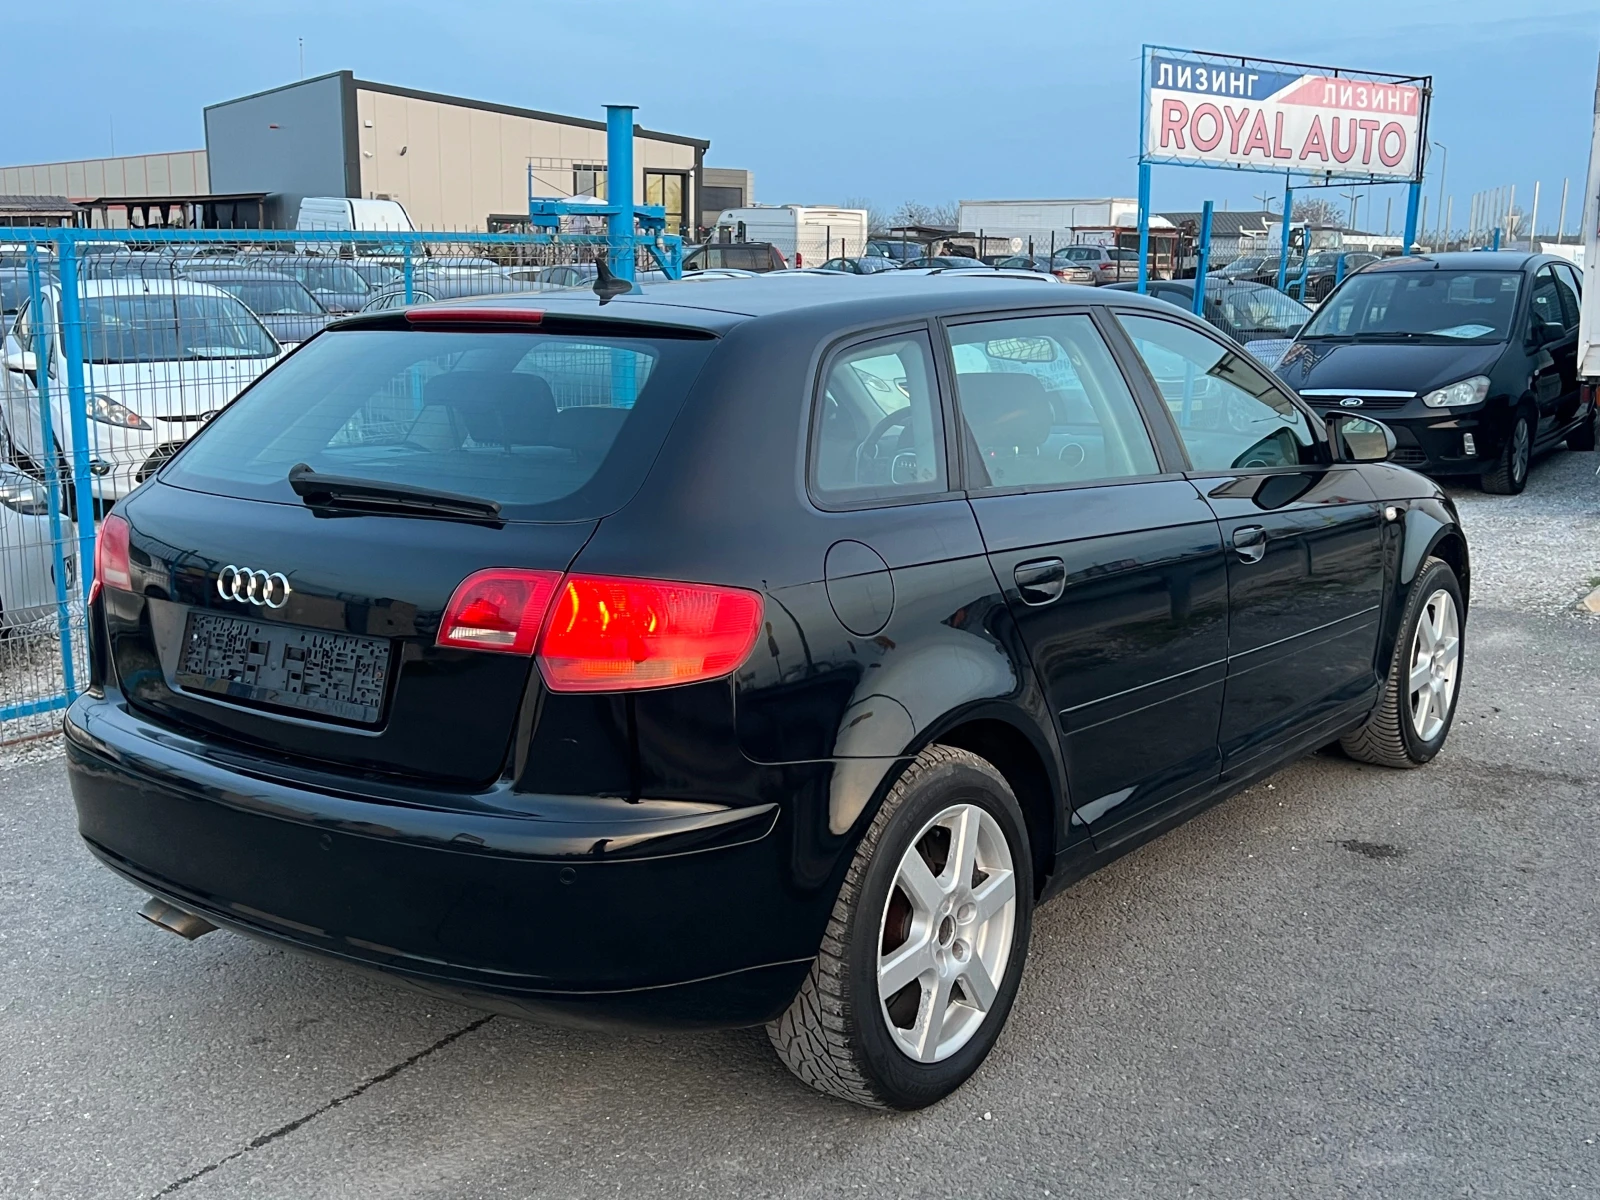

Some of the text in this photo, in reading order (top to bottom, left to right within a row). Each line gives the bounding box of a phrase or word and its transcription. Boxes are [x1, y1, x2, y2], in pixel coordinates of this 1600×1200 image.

[1157, 63, 1259, 96] ЛИЗИНГ
[1322, 83, 1415, 111] ЛИЗИНГ
[1160, 98, 1406, 167] ROYAL AUTO
